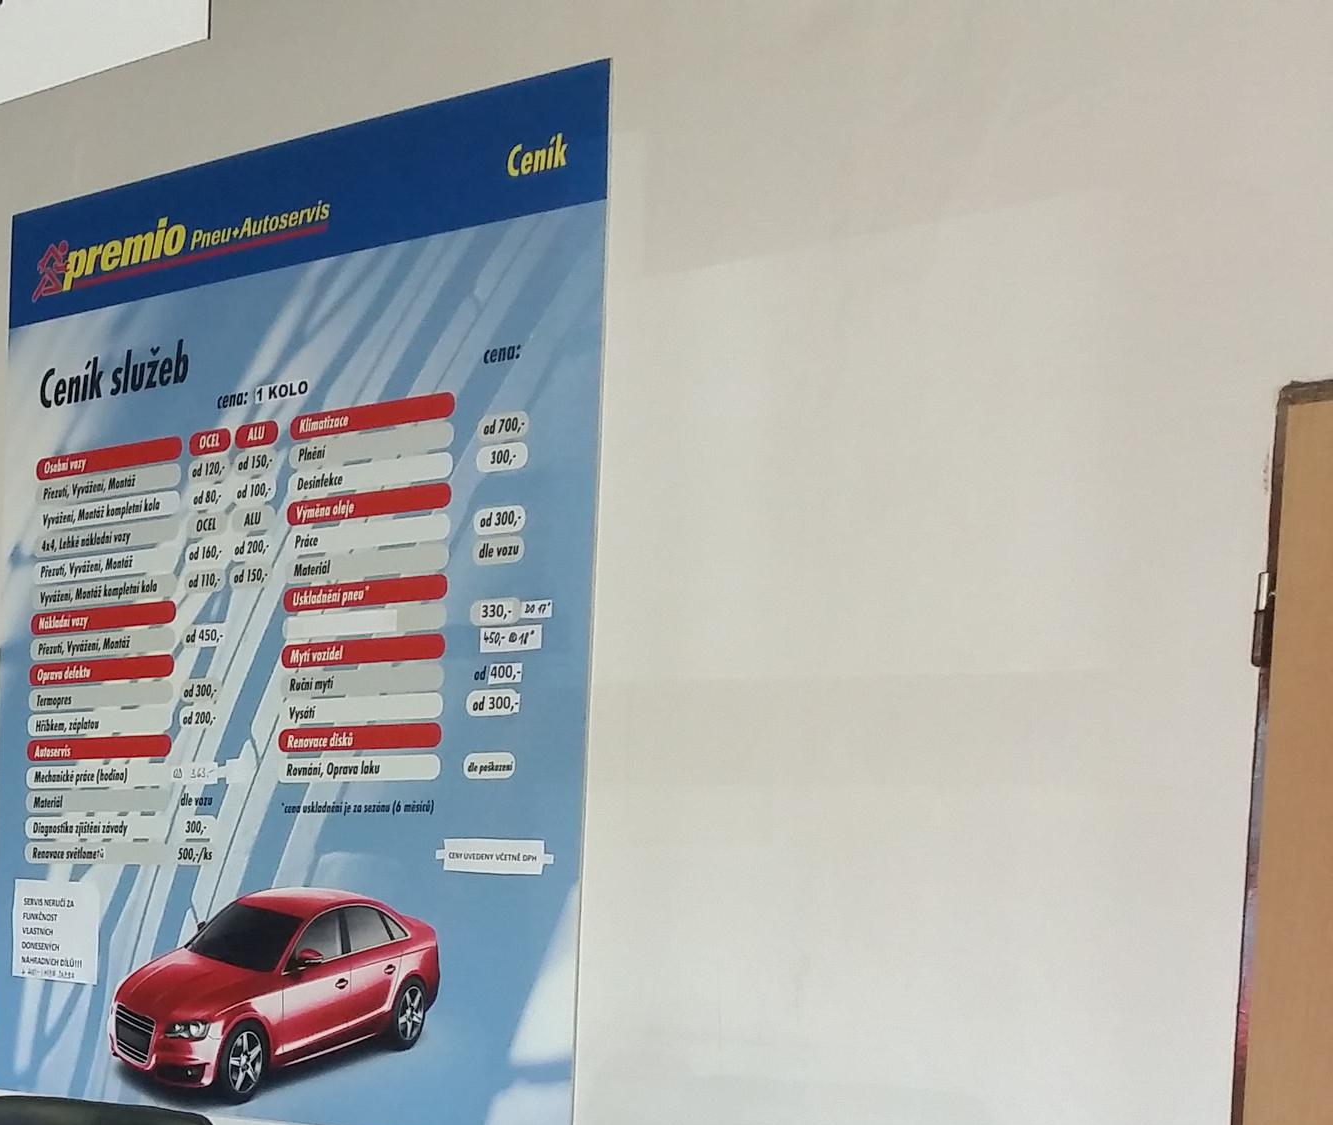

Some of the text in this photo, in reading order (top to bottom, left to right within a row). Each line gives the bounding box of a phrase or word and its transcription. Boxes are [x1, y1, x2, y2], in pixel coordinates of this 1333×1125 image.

[507, 133, 568, 177] Ceník
[64, 218, 185, 291] premio
[483, 344, 521, 365] cena:
[40, 338, 189, 408] Ceník služeb
[217, 380, 308, 409] cena: 1 KOLO
[299, 415, 350, 433] Klimatizace
[483, 421, 495, 436] od
[199, 433, 221, 449] OCEL
[247, 426, 265, 442] ALU
[298, 445, 326, 462] Plnění
[490, 449, 517, 465] 300,-
[44, 458, 87, 474] Osobní vozy
[192, 464, 203, 478] od
[238, 456, 249, 470] od
[108, 474, 135, 490] Montáž
[297, 474, 343, 491] Desinfekce
[193, 492, 204, 505] od
[237, 484, 248, 499] od
[77, 505, 105, 522] Montáž
[144, 499, 160, 512] kola
[296, 500, 354, 523] Výměna oleje
[196, 518, 216, 532] OCEL
[243, 512, 261, 526] ALU
[480, 510, 521, 528] od 300,-
[59, 536, 79, 550] Lehké
[113, 531, 131, 547] vozy
[234, 540, 246, 554] od
[295, 535, 319, 549] Práce
[189, 546, 200, 561] od
[478, 543, 519, 559] dle vozu
[105, 555, 133, 570] Montáž
[293, 560, 330, 577] Materiál
[188, 574, 199, 588] od
[233, 568, 245, 582] od
[75, 585, 102, 602] Montáž
[141, 580, 157, 592] kola
[293, 586, 341, 606] Uskladnění
[482, 604, 512, 620] 330,-
[39, 615, 88, 630] Nákladní vozy
[103, 635, 131, 650] Montáž
[186, 627, 223, 642] od 450,-
[290, 644, 343, 665] Mytí vozidel
[37, 666, 91, 682] Oprava defektu
[474, 665, 521, 681] od 400,-
[183, 682, 217, 698] od 300,-
[289, 676, 334, 692] Ruční mytí
[37, 694, 72, 709] Termopres
[473, 696, 519, 712] od 300,-
[183, 709, 217, 725] od 200,-
[289, 705, 317, 720] Vysátí
[69, 718, 99, 733] záplatou
[287, 732, 353, 749] Renovace disků
[34, 745, 71, 758] Autoservis
[34, 768, 73, 783] Mechanické
[75, 770, 95, 784] práce
[286, 761, 380, 778] Rovnání, Oprava laku
[33, 796, 63, 808] Materiál
[181, 793, 213, 806] dle vozu
[344, 802, 351, 816] je
[353, 804, 361, 813] za
[33, 821, 73, 836] Diagnostika
[101, 821, 127, 836] závady
[185, 821, 206, 835] 300,-
[32, 848, 64, 859] Renovace
[496, 853, 520, 861] VČETNĚ
